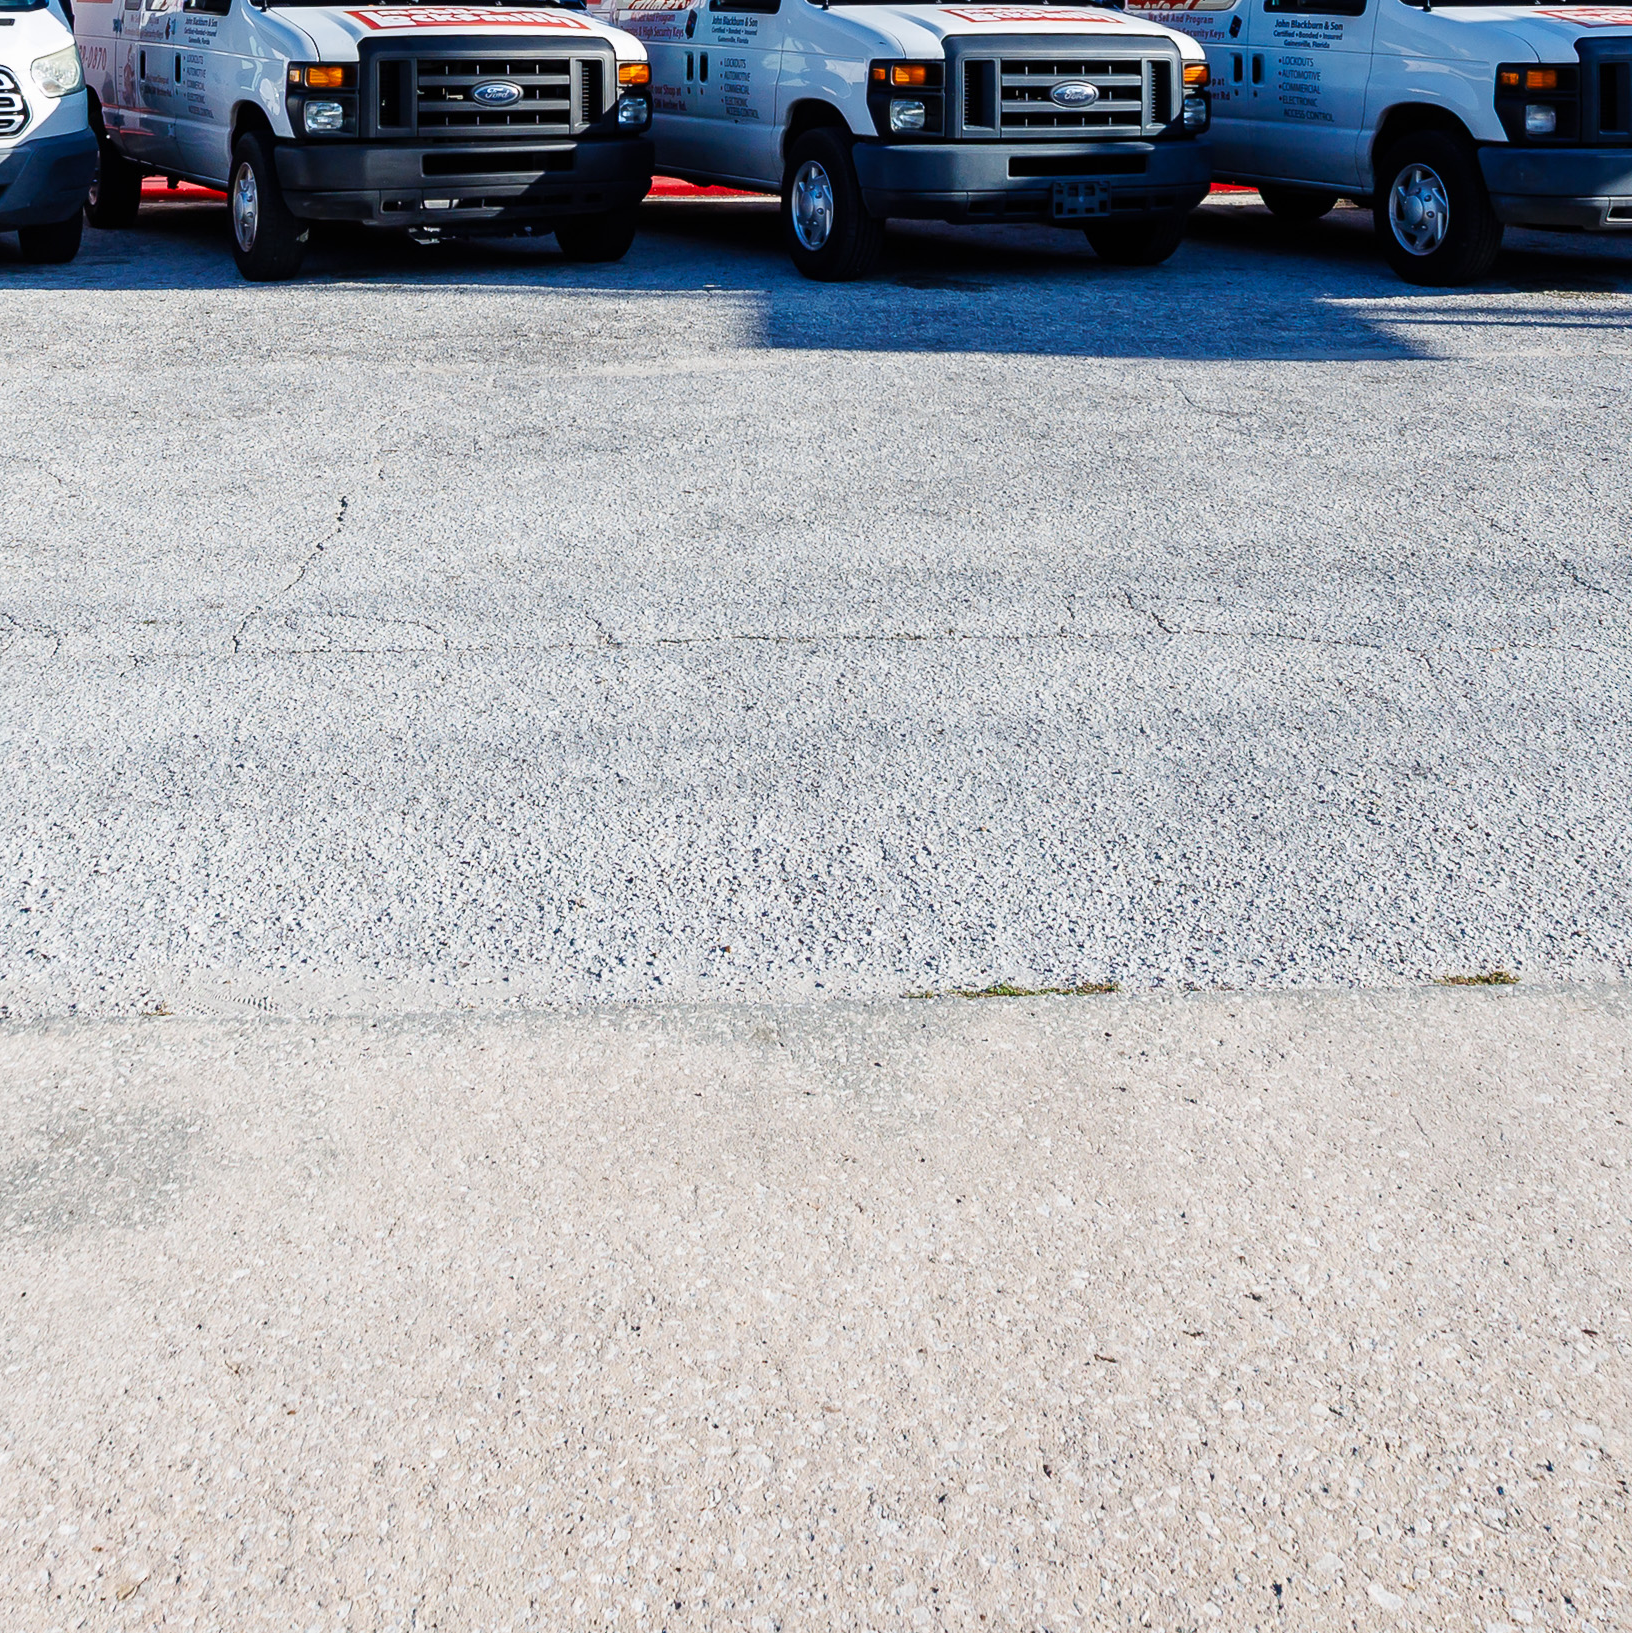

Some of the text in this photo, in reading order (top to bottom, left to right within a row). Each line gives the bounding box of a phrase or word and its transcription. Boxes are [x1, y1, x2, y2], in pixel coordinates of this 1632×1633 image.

[1171, 14, 1184, 23] And
[1185, 15, 1214, 25] Program
[1275, 19, 1343, 31] John Blackburn & Son
[1210, 29, 1225, 40] Keys
[1298, 31, 1319, 39] Bonded
[1282, 56, 1314, 67] LOCKOUTS
[1281, 69, 1321, 81] AUTOMOTIVE
[485, 87, 509, 98] Ford
[1282, 82, 1321, 94] COMMERCIAL
[1064, 89, 1086, 100] Ford
[1282, 95, 1318, 107] ELECTRONIC
